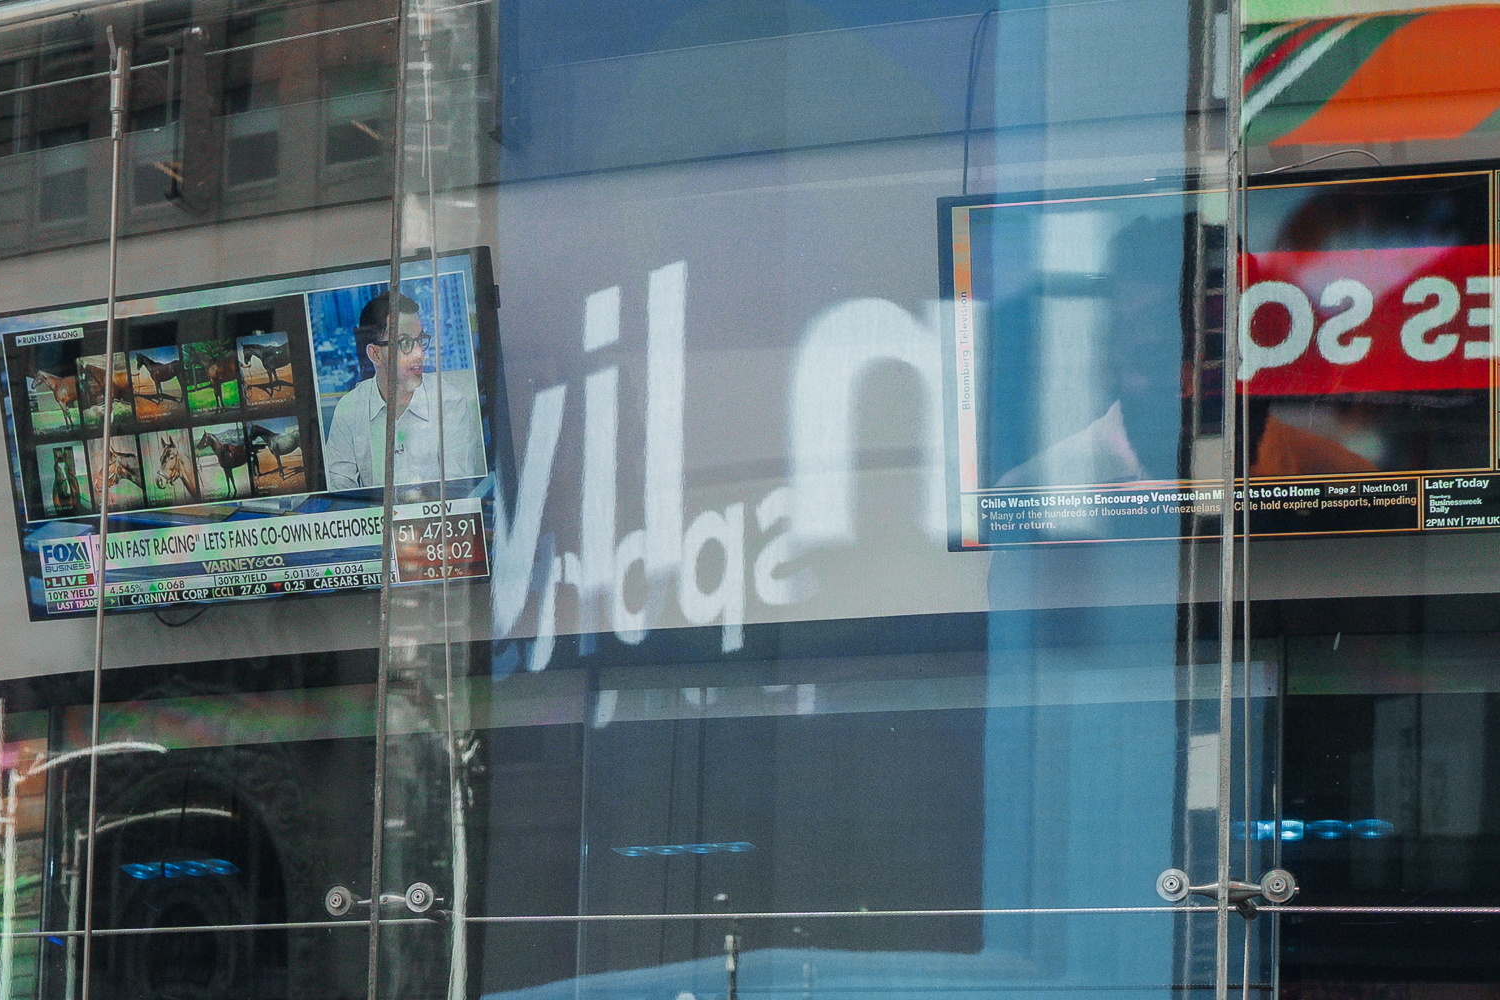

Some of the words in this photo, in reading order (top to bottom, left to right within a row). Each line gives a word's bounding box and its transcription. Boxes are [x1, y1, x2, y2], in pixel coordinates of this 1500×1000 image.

[960, 291, 969, 346] Television
[22, 335, 36, 345] RUN
[37, 333, 51, 344] FAST
[52, 330, 78, 342] RACING
[961, 350, 971, 410] Bloomberg
[1362, 483, 1381, 493] Next
[1382, 483, 1391, 493] In
[1392, 483, 1408, 493] 0:11
[1425, 479, 1454, 489] Later
[1455, 478, 1489, 489] Today
[1328, 485, 1349, 496] Page
[1350, 485, 1356, 494] 2
[981, 499, 1006, 509] Chile
[1008, 496, 1040, 508] Wants
[1041, 496, 1055, 507] US
[1057, 494, 1080, 508] Help
[1082, 494, 1093, 504] to
[1094, 492, 1149, 506] Encourage
[1151, 489, 1211, 503] Venezuelan
[1212, 488, 1260, 500] Mirats
[1261, 487, 1272, 498] to
[1273, 486, 1288, 498] Go
[1289, 486, 1320, 497] Home
[1430, 498, 1482, 506] Businessweek
[422, 503, 452, 515] DOW
[990, 510, 1013, 521] Many
[1015, 510, 1025, 519] of
[1028, 509, 1042, 519] the
[1044, 508, 1086, 519] hundreds
[1089, 507, 1099, 517] of
[1101, 505, 1148, 516] thousands
[1150, 504, 1160, 515] of
[1162, 503, 1221, 514] Venezuelans
[1234, 501, 1258, 511] Cle
[1260, 500, 1281, 510] hold
[1284, 499, 1319, 511] expired
[1321, 497, 1371, 509] passports,
[1373, 495, 1416, 507] impeding
[1430, 506, 1450, 514] Daily
[990, 522, 1015, 531] their
[1019, 520, 1056, 530] return.
[1426, 518, 1445, 527] 2PM
[1447, 518, 1460, 526] NY
[1466, 517, 1485, 525] 7PM
[1487, 516, 1500, 525] UK
[96, 541, 124, 560] "UN
[126, 539, 150, 558] FAST
[153, 534, 200, 555] RACING"
[204, 531, 227, 551] LETS
[229, 528, 259, 547] FANS
[260, 523, 313, 544] CO-OWN
[43, 541, 79, 563] FOX
[426, 541, 473, 562] 88.02
[45, 562, 92, 573] BUSINESS
[47, 590, 69, 601] 10YR
[70, 588, 95, 600] YIELD
[110, 583, 144, 595] 4.545%
[157, 580, 185, 591] 0.068
[217, 574, 240, 585] 30YR
[242, 572, 268, 583] YIELD
[284, 569, 320, 580] 5.011%
[334, 564, 364, 575] 0.034
[52, 575, 88, 587] LIVE
[131, 591, 180, 605] CARNIVAL
[182, 588, 209, 600] CORP
[211, 586, 235, 598] (CCL)
[240, 584, 267, 595] 27.60
[284, 580, 305, 592] 0.25
[313, 576, 359, 589] CAESARS
[56, 601, 74, 610] LAST
[75, 599, 98, 609] TRADE
